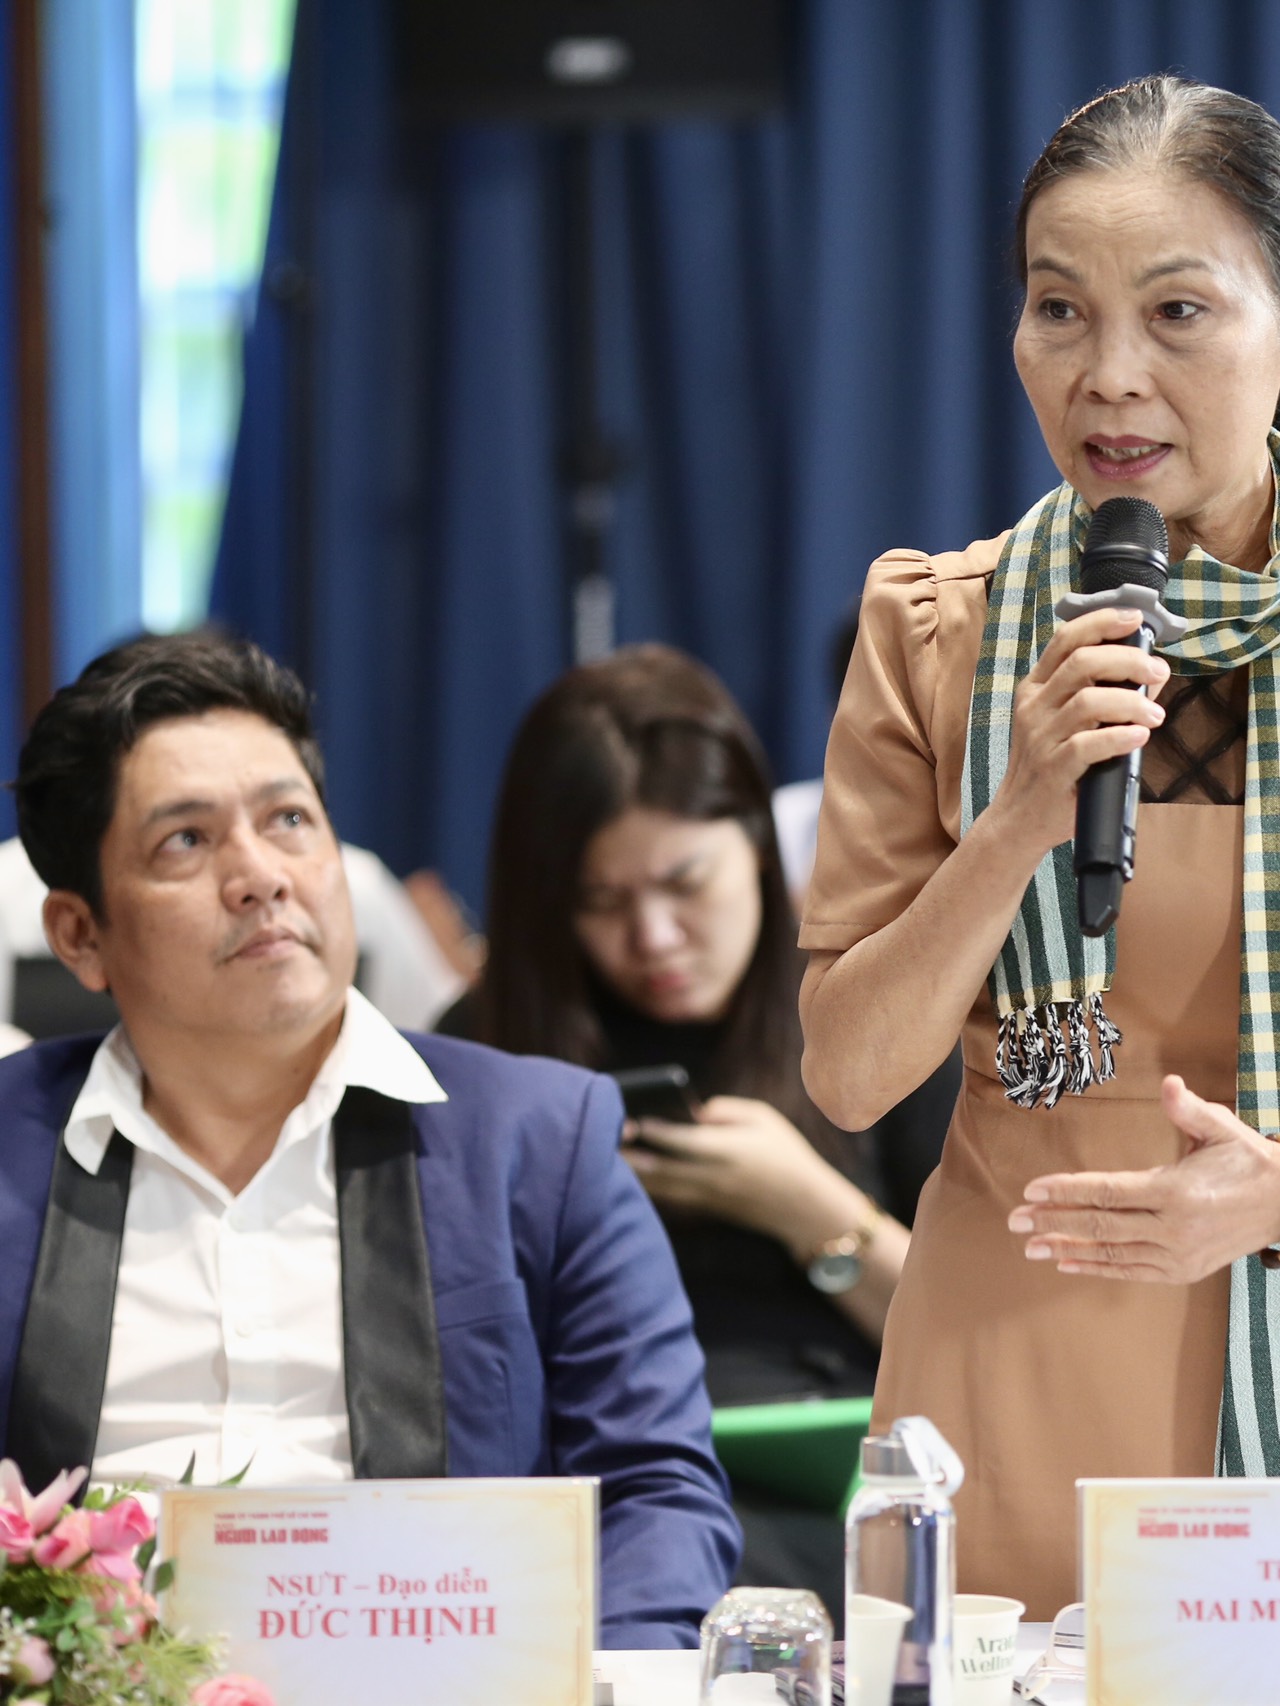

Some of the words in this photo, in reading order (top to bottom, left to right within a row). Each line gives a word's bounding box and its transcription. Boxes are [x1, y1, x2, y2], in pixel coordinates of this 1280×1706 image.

[378, 1574, 428, 1600] Đạo
[435, 1567, 489, 1594] diễn
[258, 1600, 349, 1639] ĐỨC
[359, 1606, 498, 1644] THỊNH
[1177, 1599, 1240, 1622] MAI
